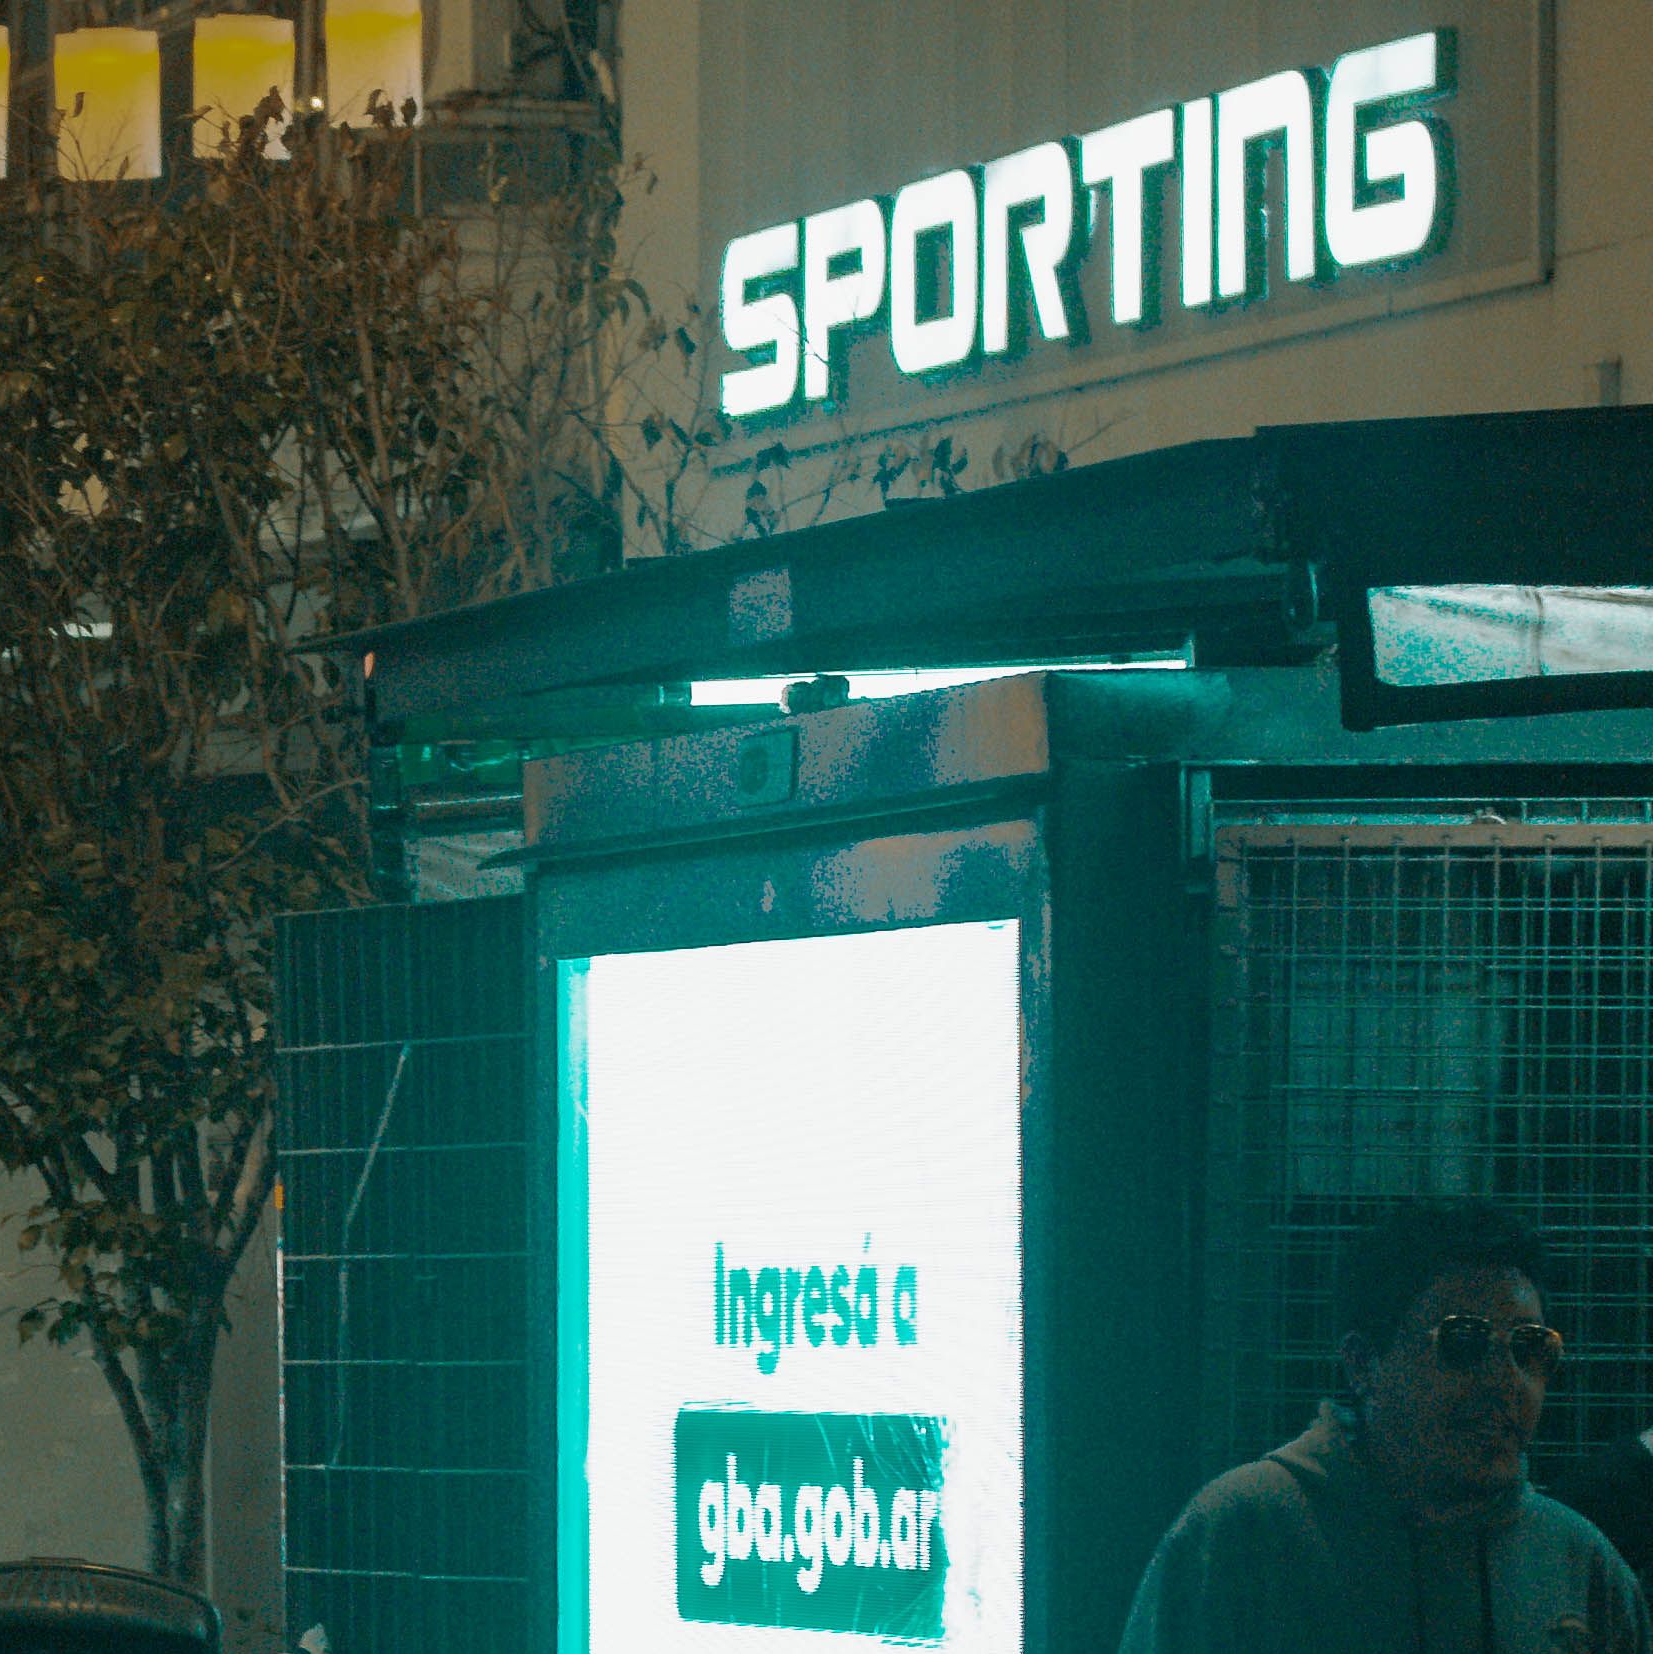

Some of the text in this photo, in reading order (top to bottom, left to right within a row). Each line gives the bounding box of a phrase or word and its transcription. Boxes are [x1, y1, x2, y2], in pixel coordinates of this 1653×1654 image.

[720, 32, 1439, 418] SPORTING
[712, 1231, 918, 1375] Ingresá a
[698, 1452, 939, 1594] gba.gob.ar
